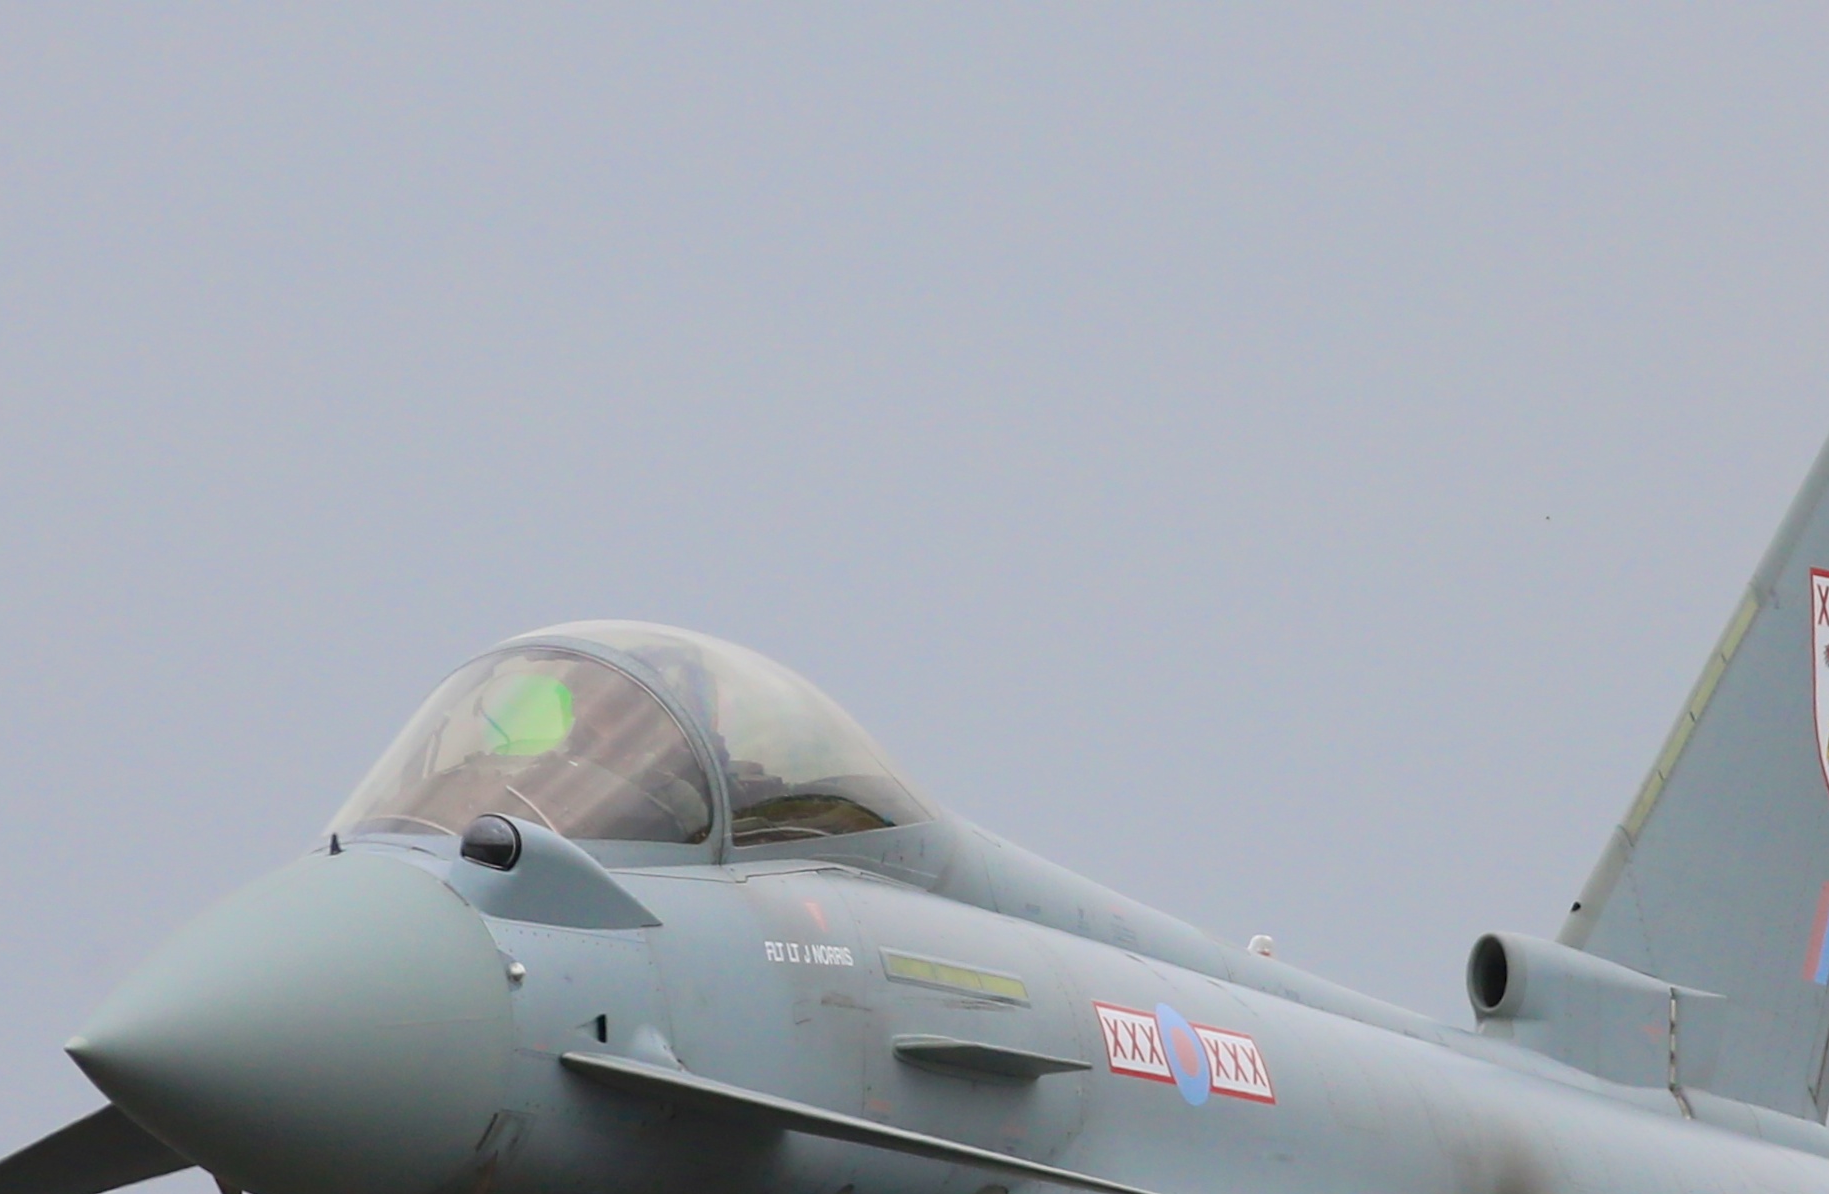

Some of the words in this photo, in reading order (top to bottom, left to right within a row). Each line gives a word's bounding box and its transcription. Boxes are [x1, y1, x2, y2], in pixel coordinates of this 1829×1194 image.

[786, 942, 800, 963] LT
[803, 944, 811, 964] J
[811, 944, 854, 967] NORRIS
[1102, 1016, 1164, 1066] XXX
[1203, 1036, 1267, 1087] XXX
